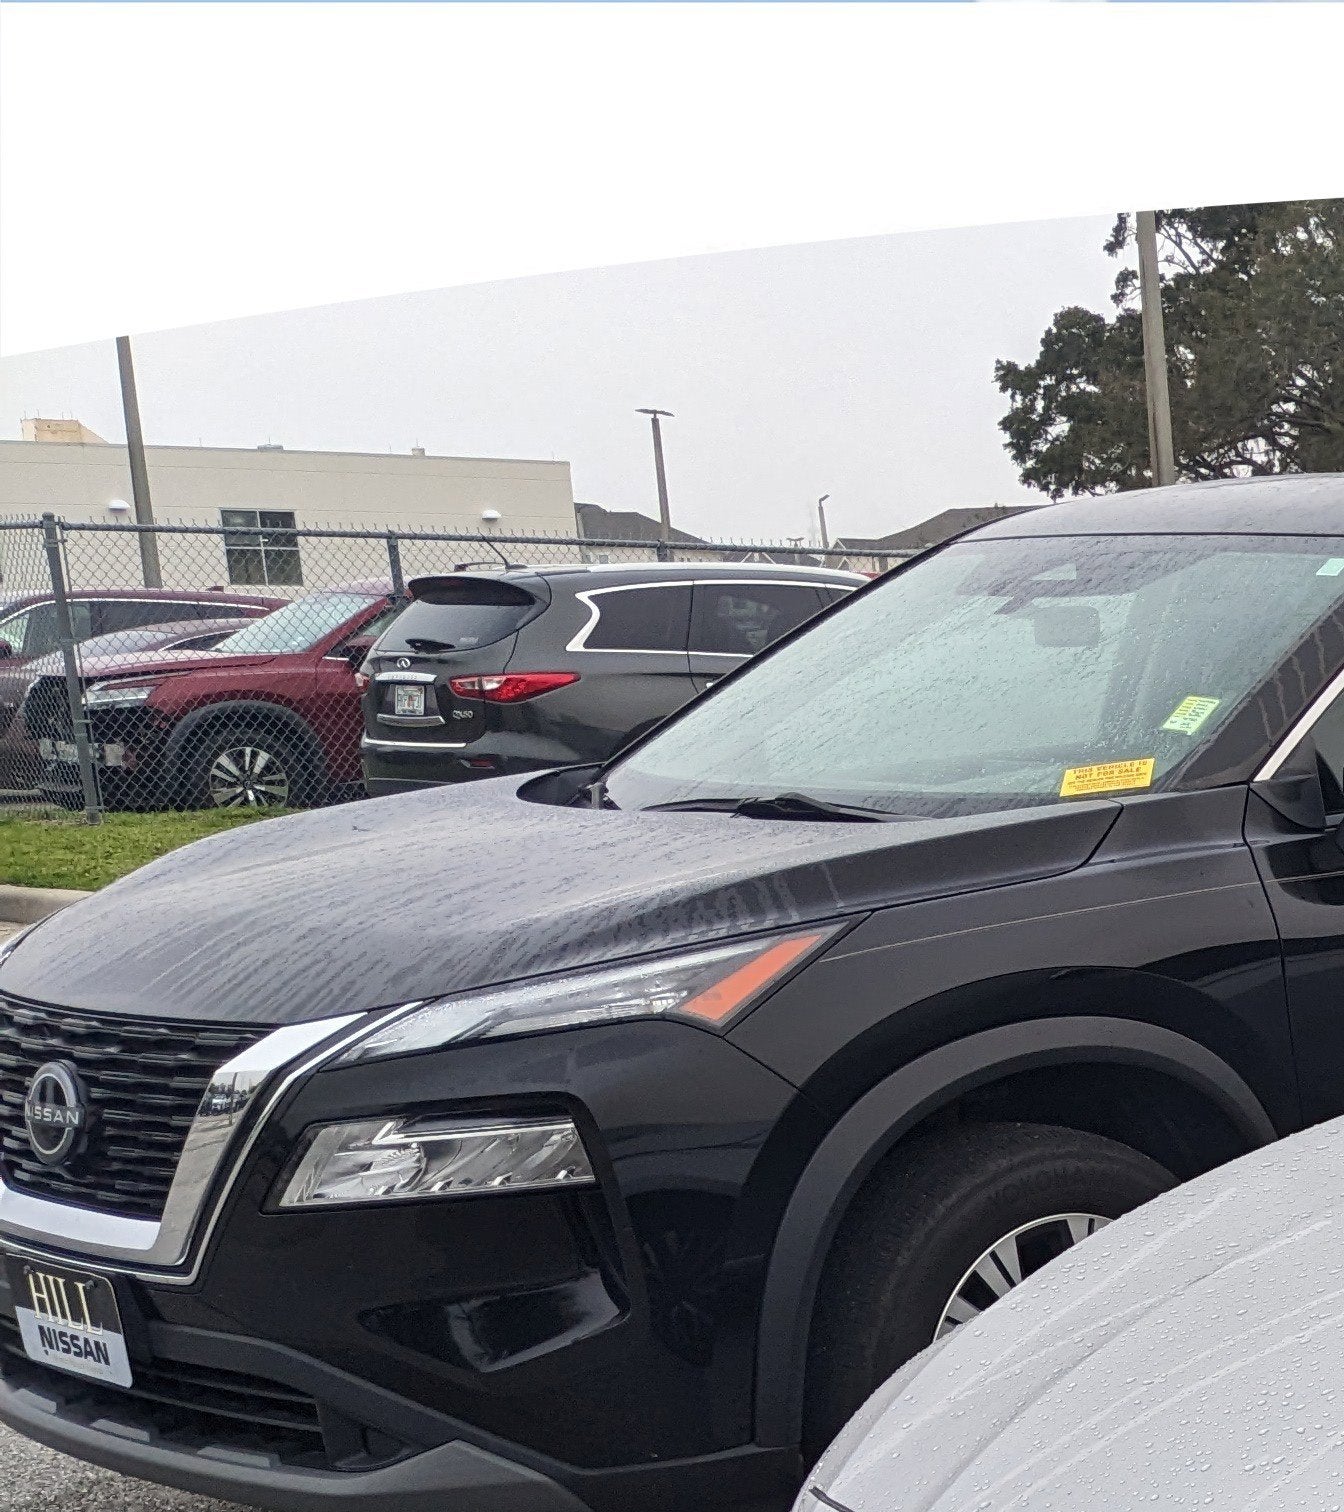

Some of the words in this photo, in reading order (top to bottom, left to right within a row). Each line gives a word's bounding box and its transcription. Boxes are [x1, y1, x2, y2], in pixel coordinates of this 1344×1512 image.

[25, 1104, 79, 1125] NISSAN
[28, 1272, 103, 1335] HILL
[37, 1324, 111, 1367] NISSAN
